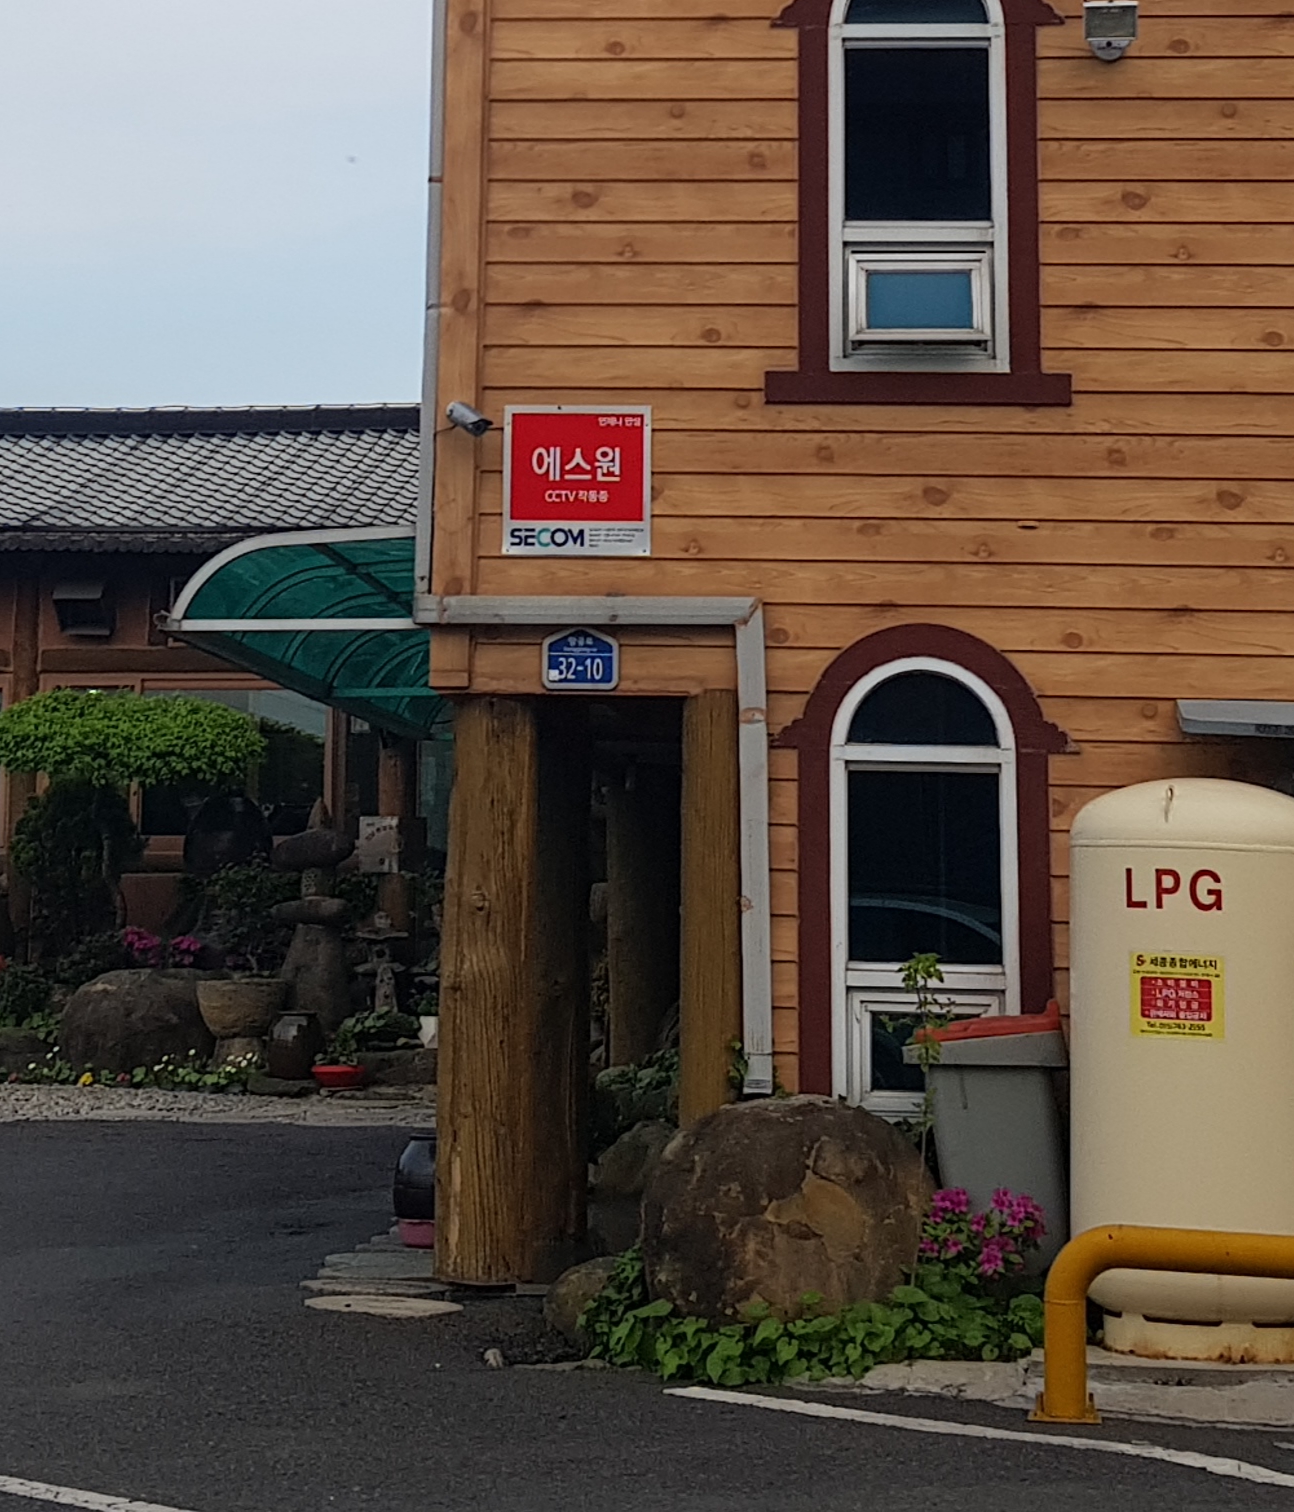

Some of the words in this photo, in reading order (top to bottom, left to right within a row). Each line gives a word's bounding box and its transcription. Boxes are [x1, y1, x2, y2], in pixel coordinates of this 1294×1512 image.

[531, 446, 621, 482] 에스원
[545, 490, 576, 502] CCTV
[577, 490, 608, 503] 작동중
[510, 528, 585, 547] SECOM
[558, 657, 603, 680] 32-10
[1125, 868, 1223, 911] LPG
